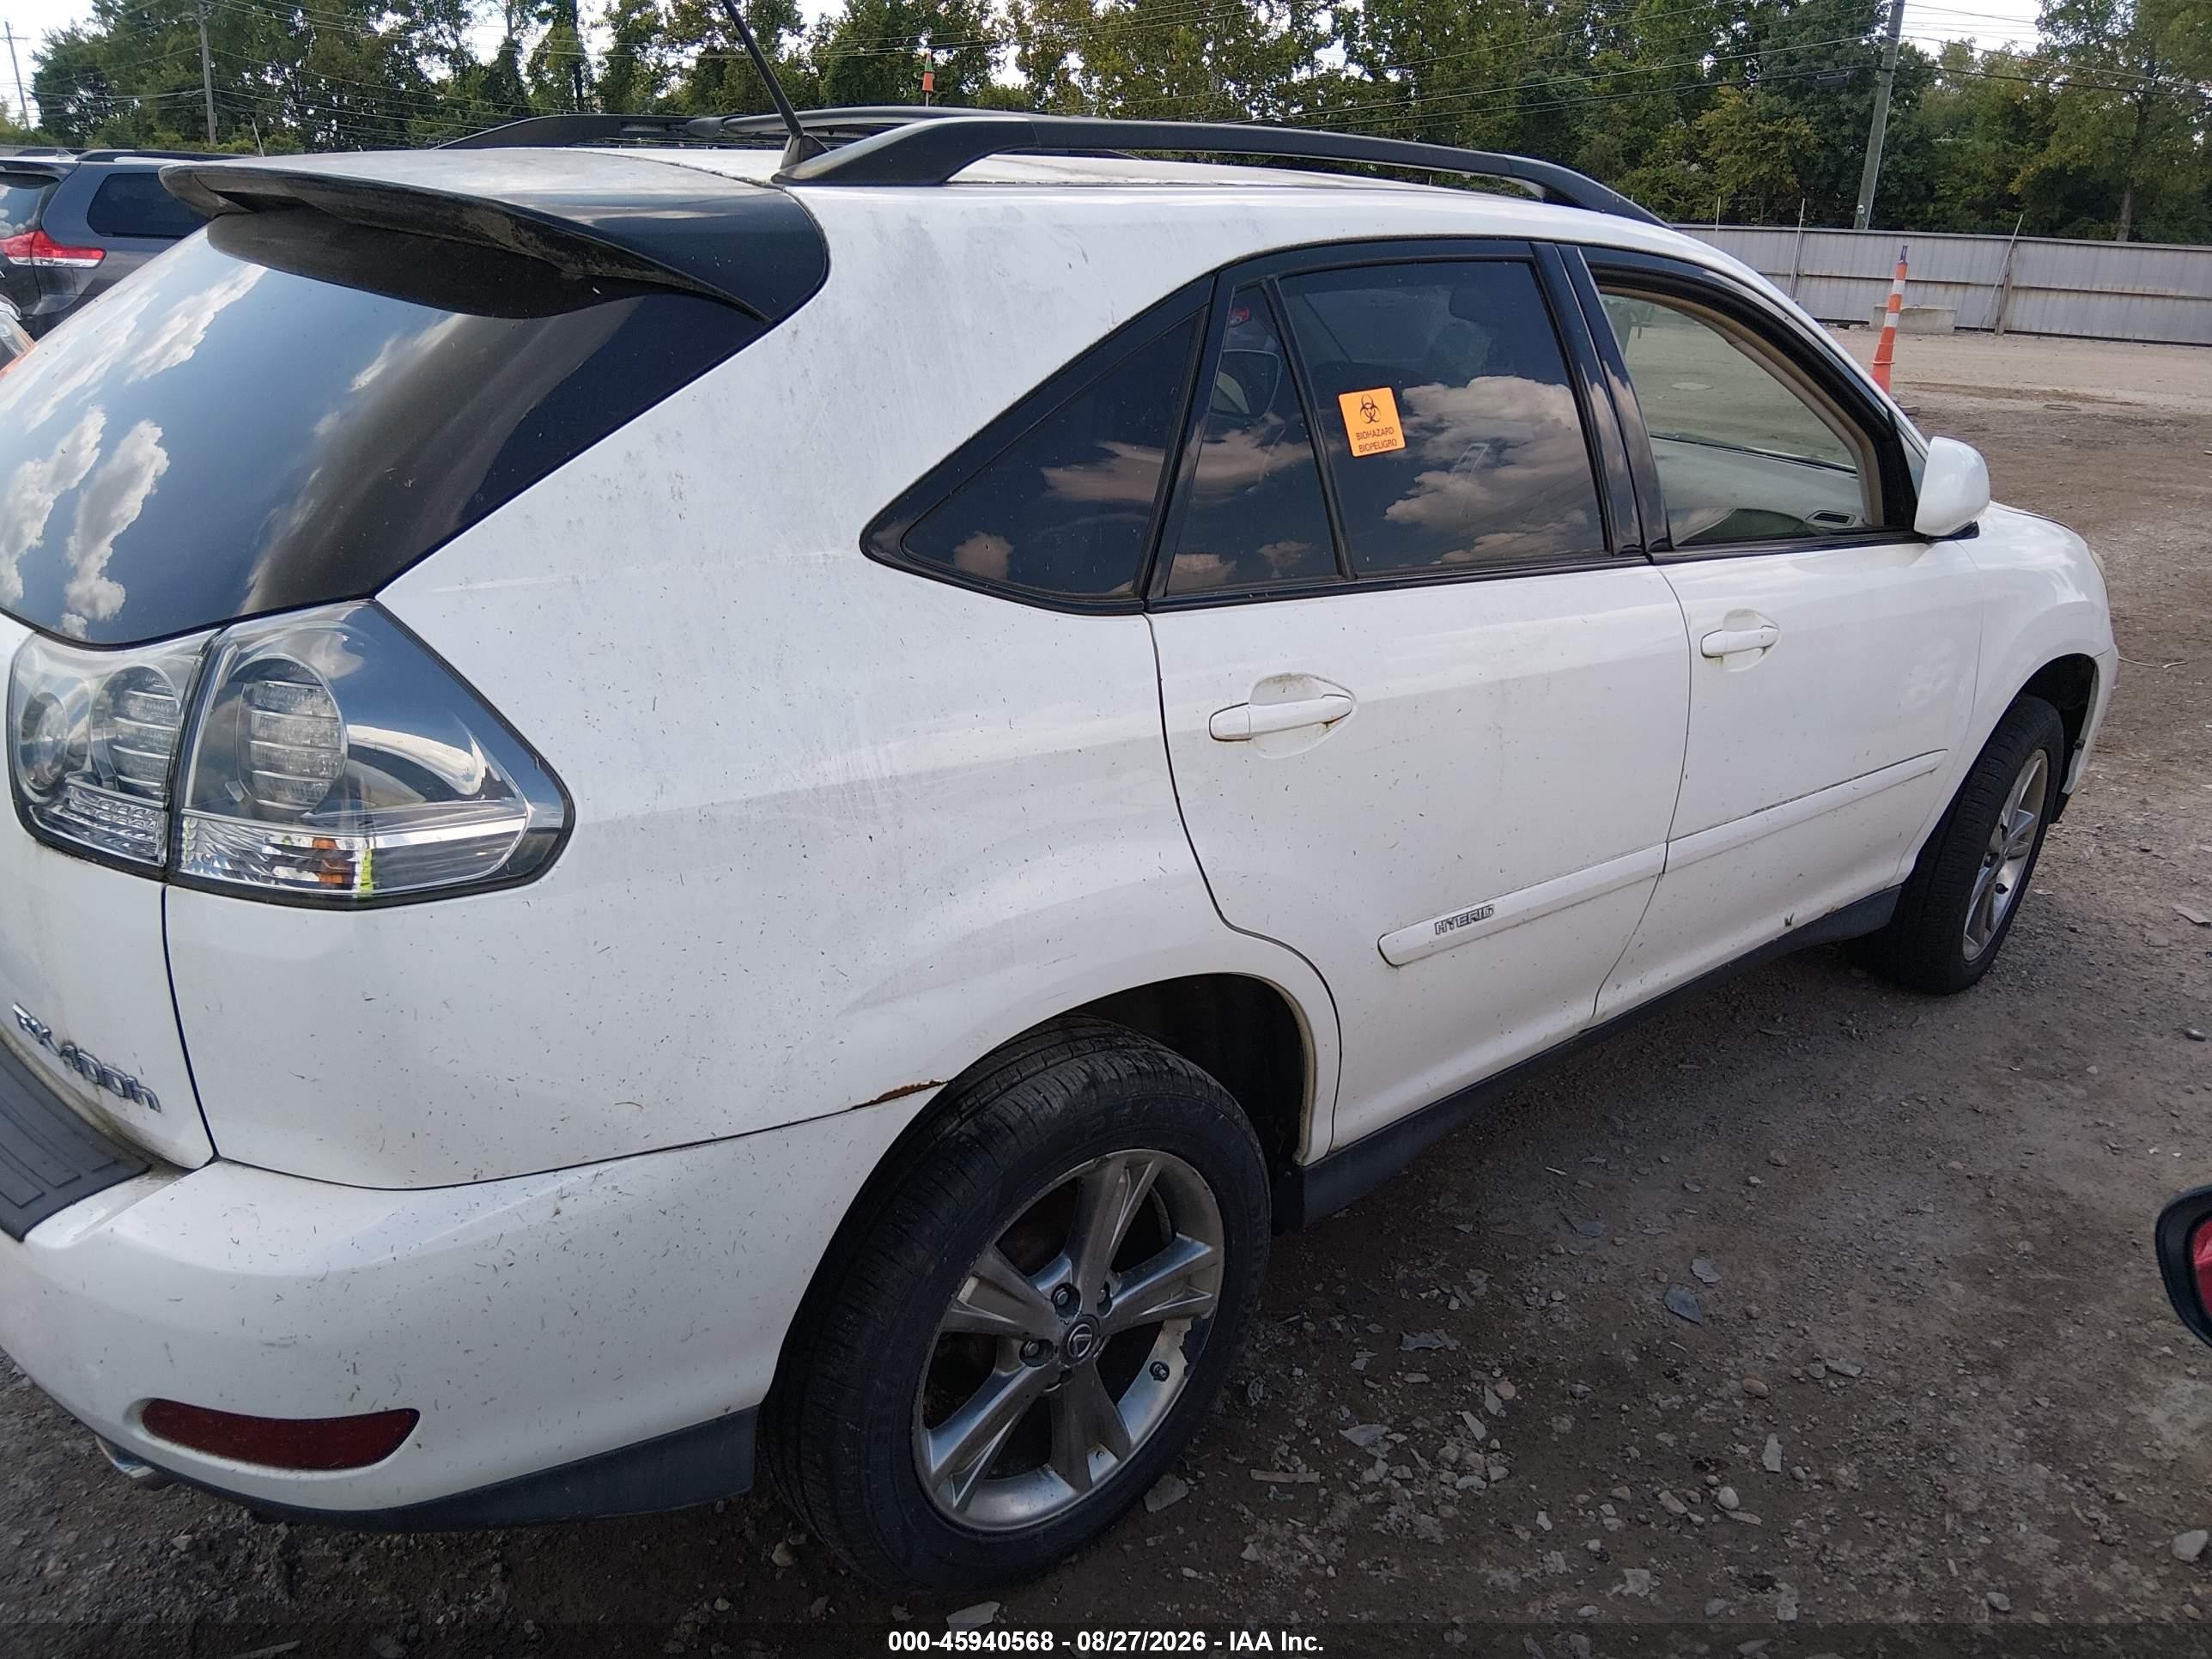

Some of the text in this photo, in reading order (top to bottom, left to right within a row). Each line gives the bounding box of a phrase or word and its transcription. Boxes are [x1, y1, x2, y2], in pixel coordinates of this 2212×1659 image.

[1356, 427, 1395, 441] BIOHAZARD
[1358, 439, 1398, 453] BIOPELIGRO
[1434, 904, 1495, 935] HYBRID
